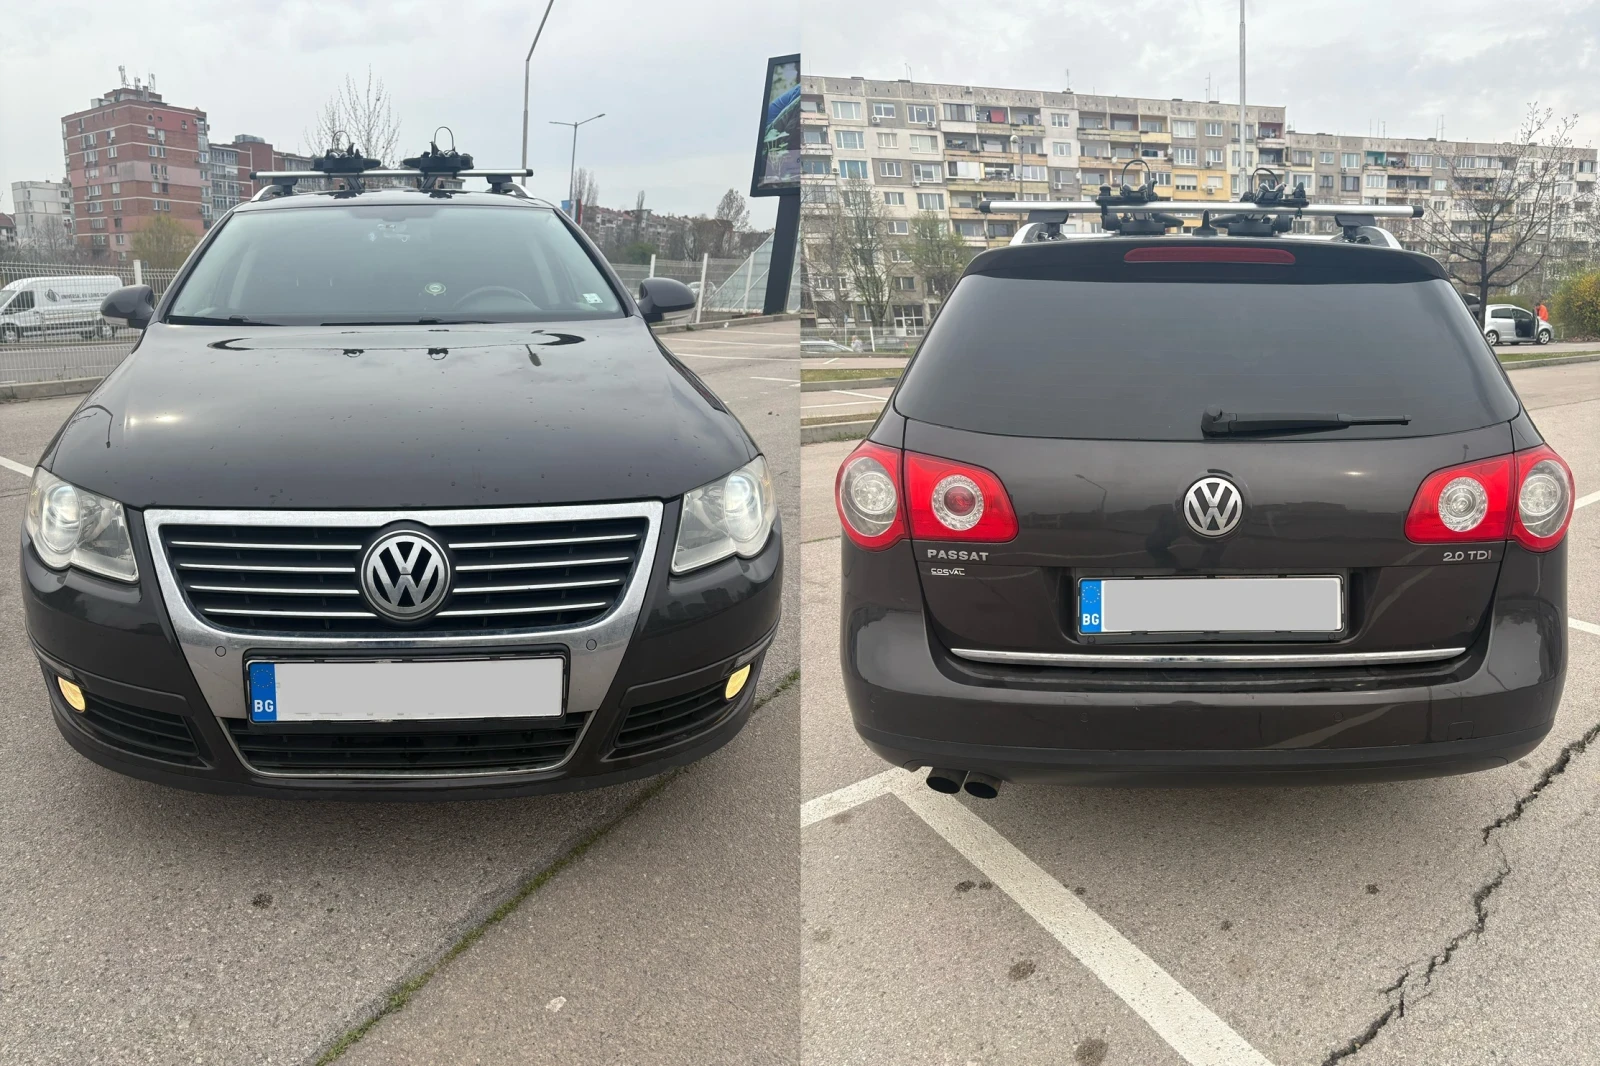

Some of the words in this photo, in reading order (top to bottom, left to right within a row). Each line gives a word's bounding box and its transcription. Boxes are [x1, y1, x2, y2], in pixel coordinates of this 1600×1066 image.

[1184, 477, 1243, 536] VW
[927, 549, 989, 561] PASSAT
[1467, 549, 1492, 561] TDI
[366, 535, 445, 614] VW
[1082, 613, 1100, 626] BG
[254, 699, 274, 713] BG
